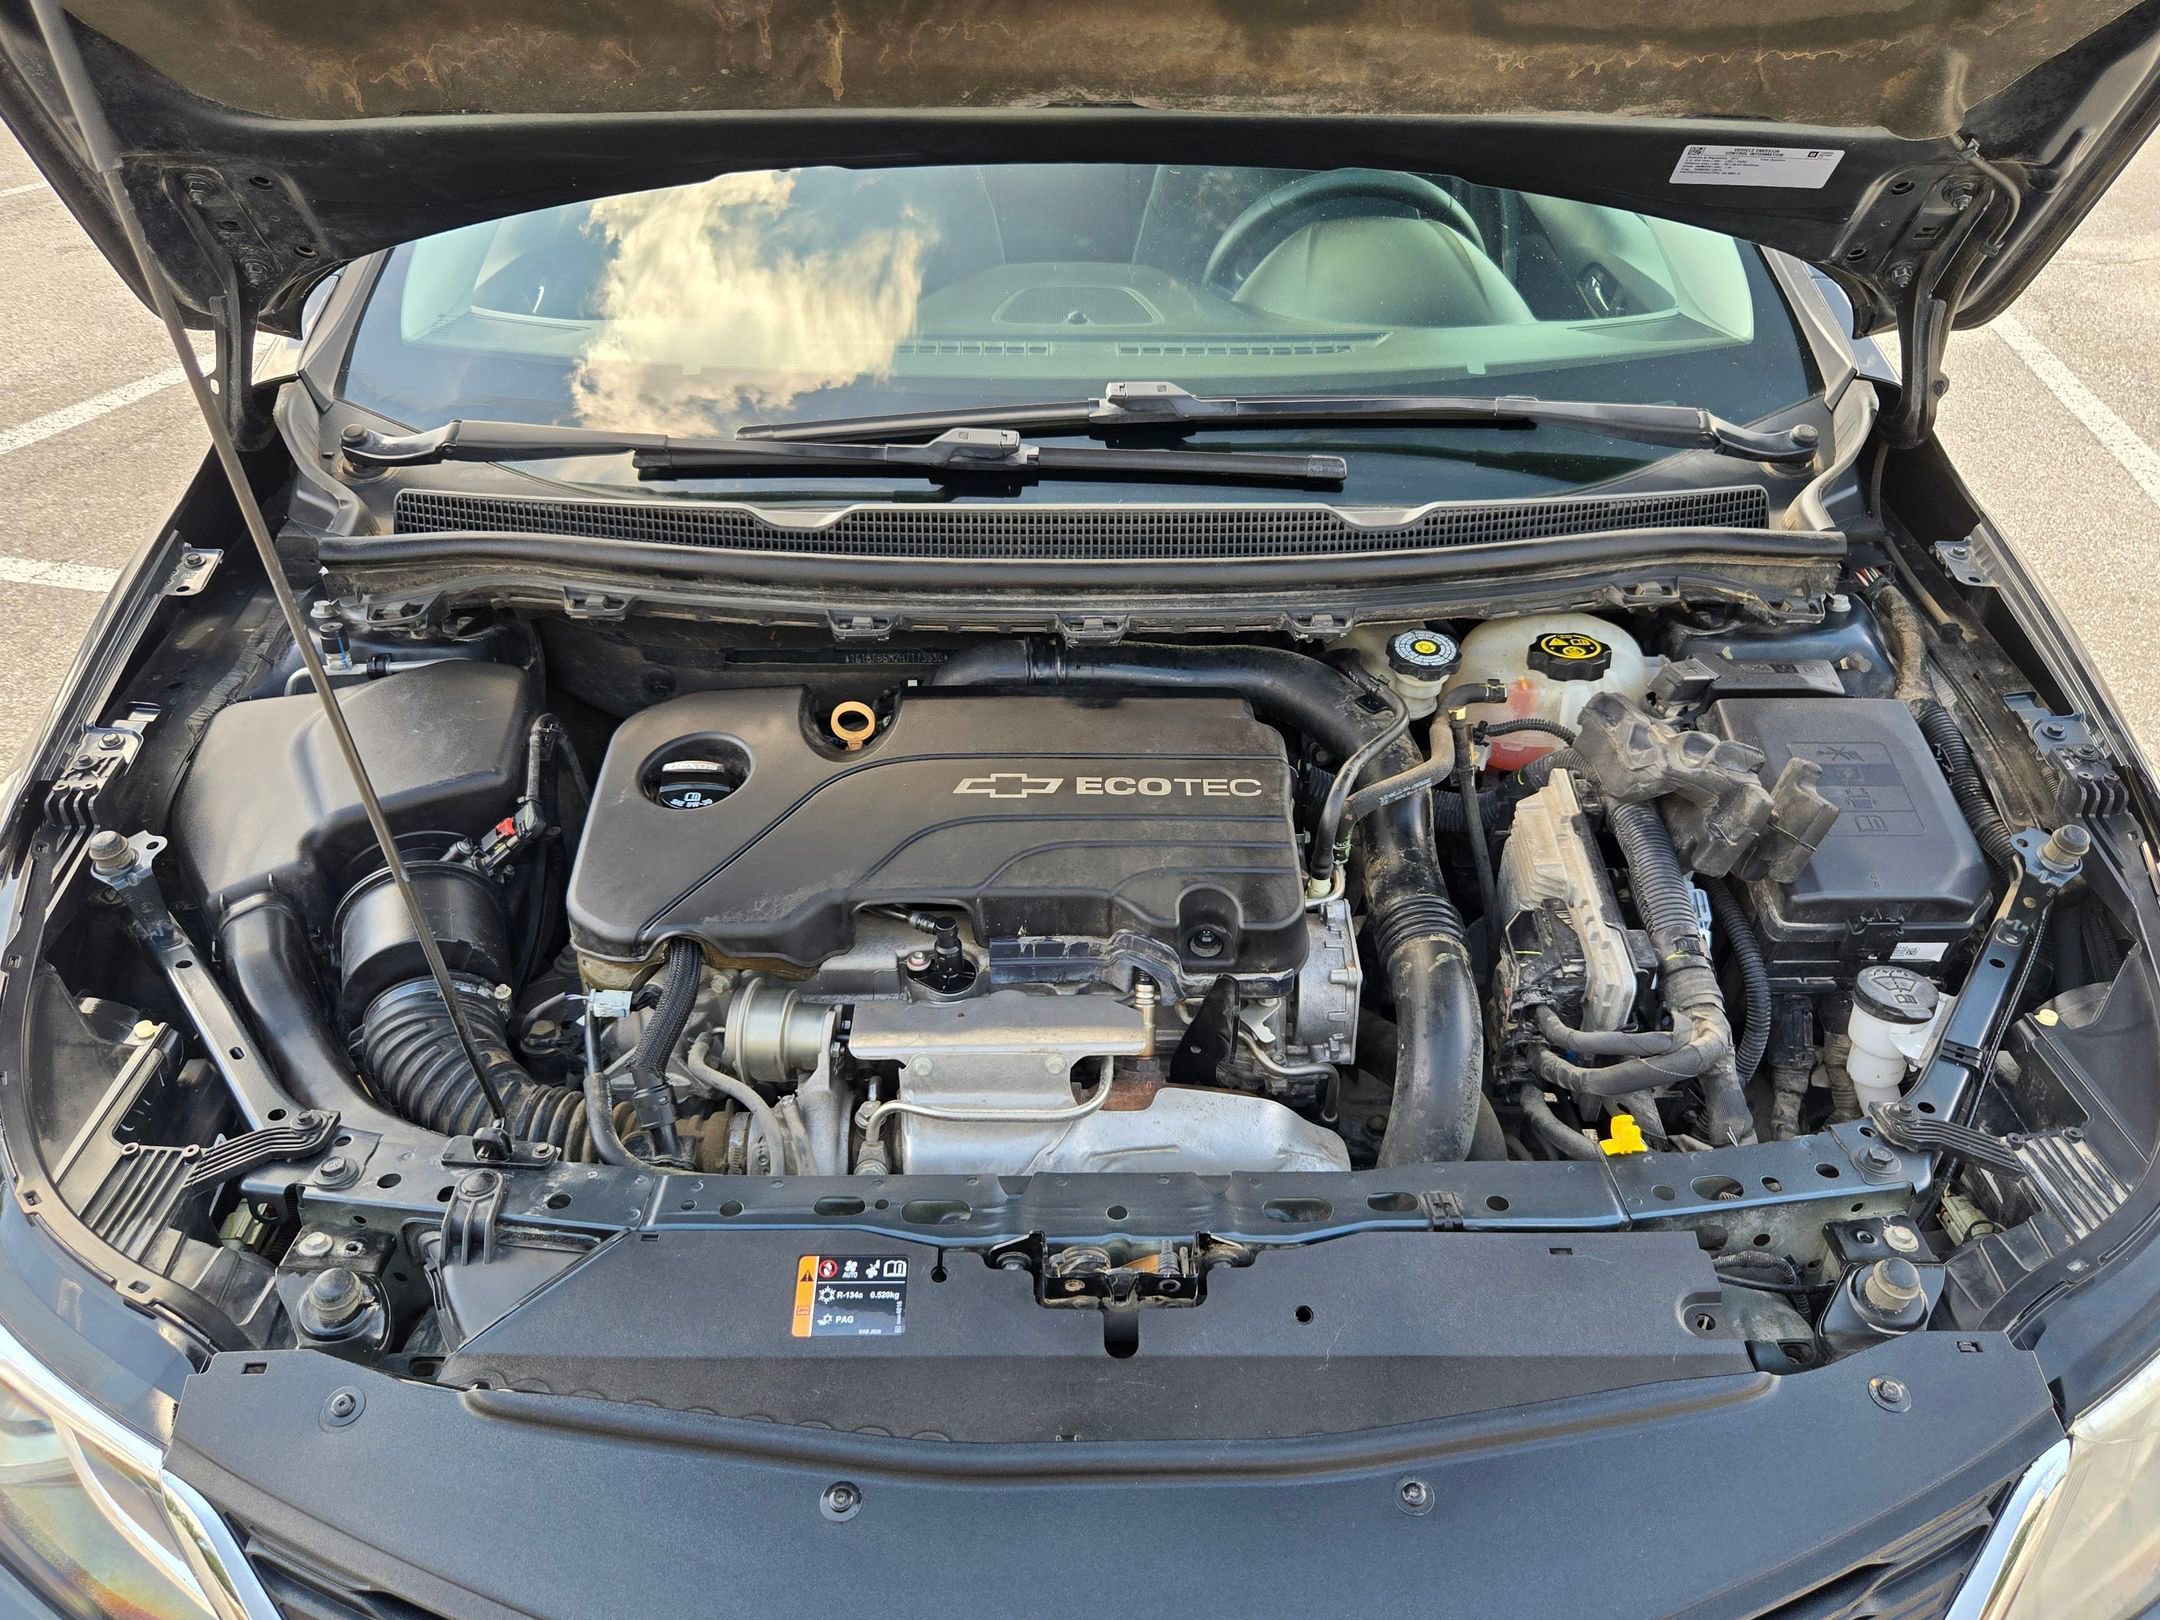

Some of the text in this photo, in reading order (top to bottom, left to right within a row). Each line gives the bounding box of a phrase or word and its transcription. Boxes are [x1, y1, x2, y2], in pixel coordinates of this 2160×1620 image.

[1076, 776, 1262, 797] ECOTEC
[836, 1290, 864, 1299] R-134a
[835, 1315, 854, 1324] PAG
